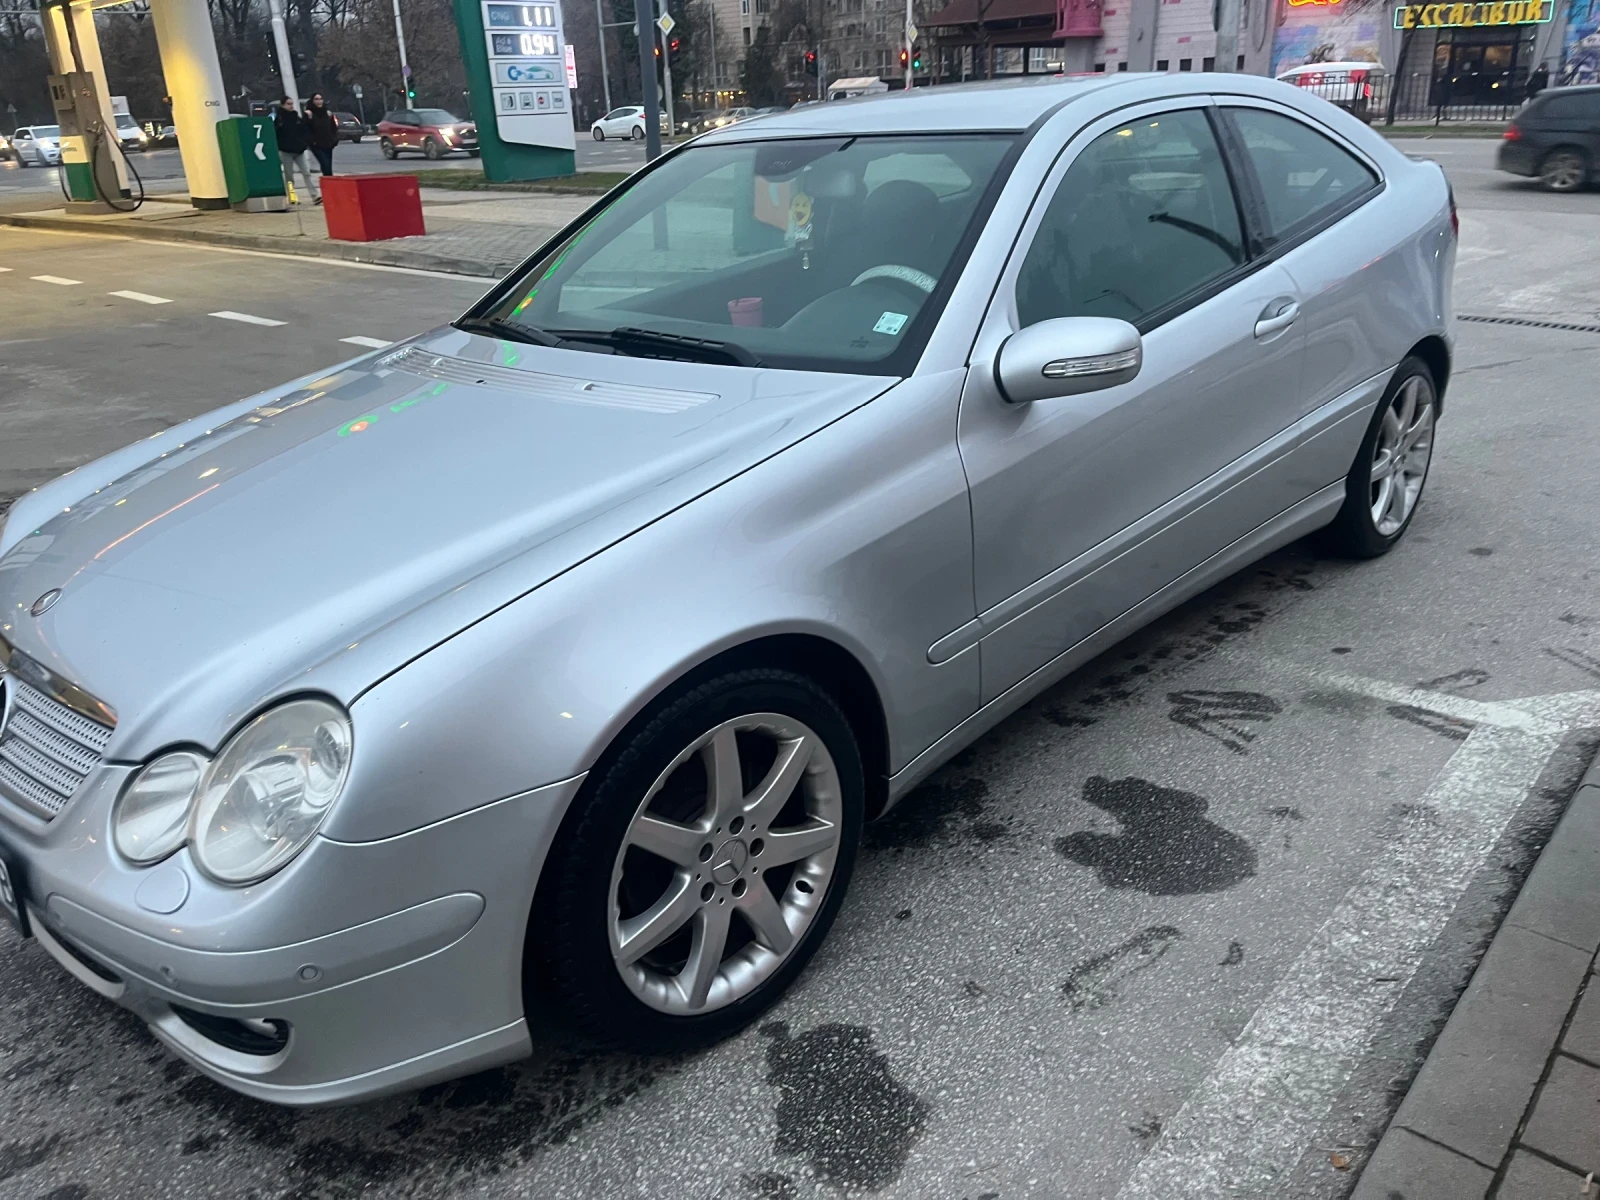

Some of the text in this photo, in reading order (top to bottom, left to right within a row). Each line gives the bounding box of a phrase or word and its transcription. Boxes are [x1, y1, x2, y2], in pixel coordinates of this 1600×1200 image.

[1403, 0, 1542, 28] EXCALIBUR
[204, 100, 221, 108] CNG
[253, 124, 262, 139] 7
